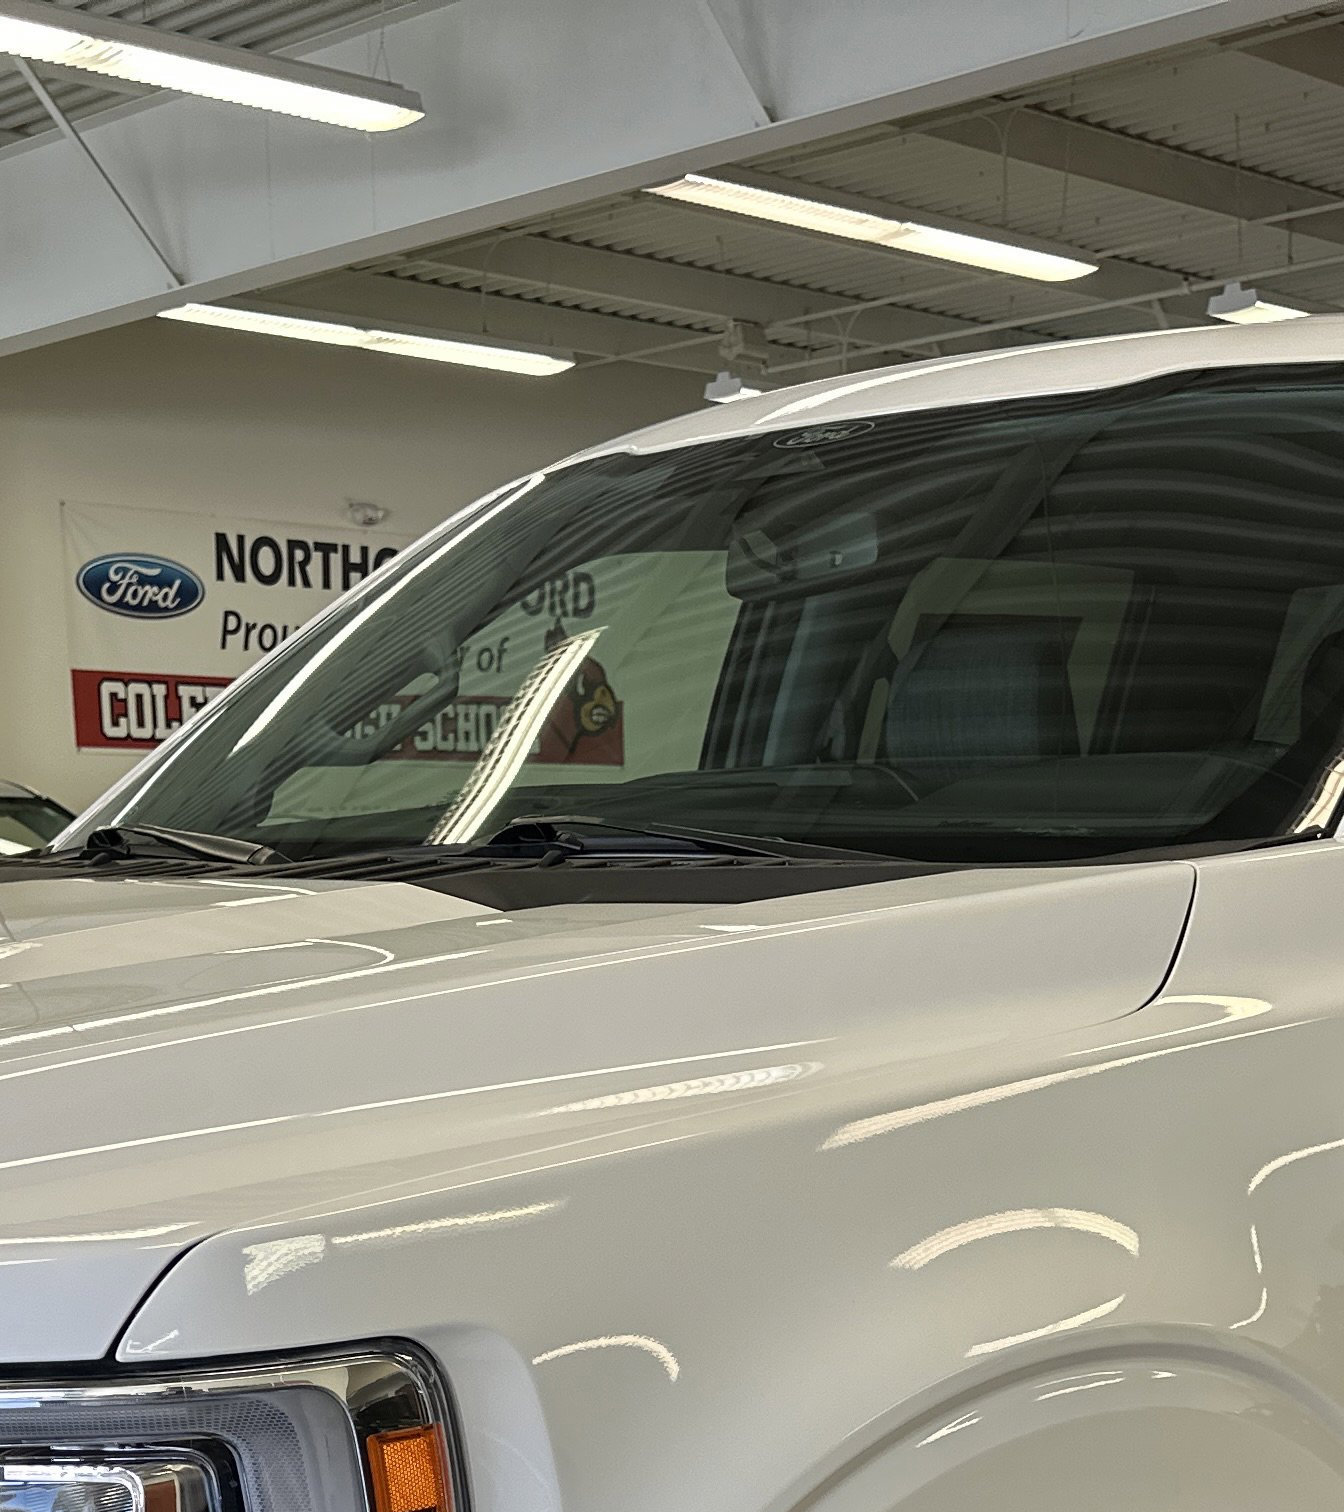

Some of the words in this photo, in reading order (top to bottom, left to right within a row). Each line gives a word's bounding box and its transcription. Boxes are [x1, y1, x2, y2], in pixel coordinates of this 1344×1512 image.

[100, 561, 181, 610] Ford
[521, 571, 596, 619] ORD
[476, 636, 510, 673] of
